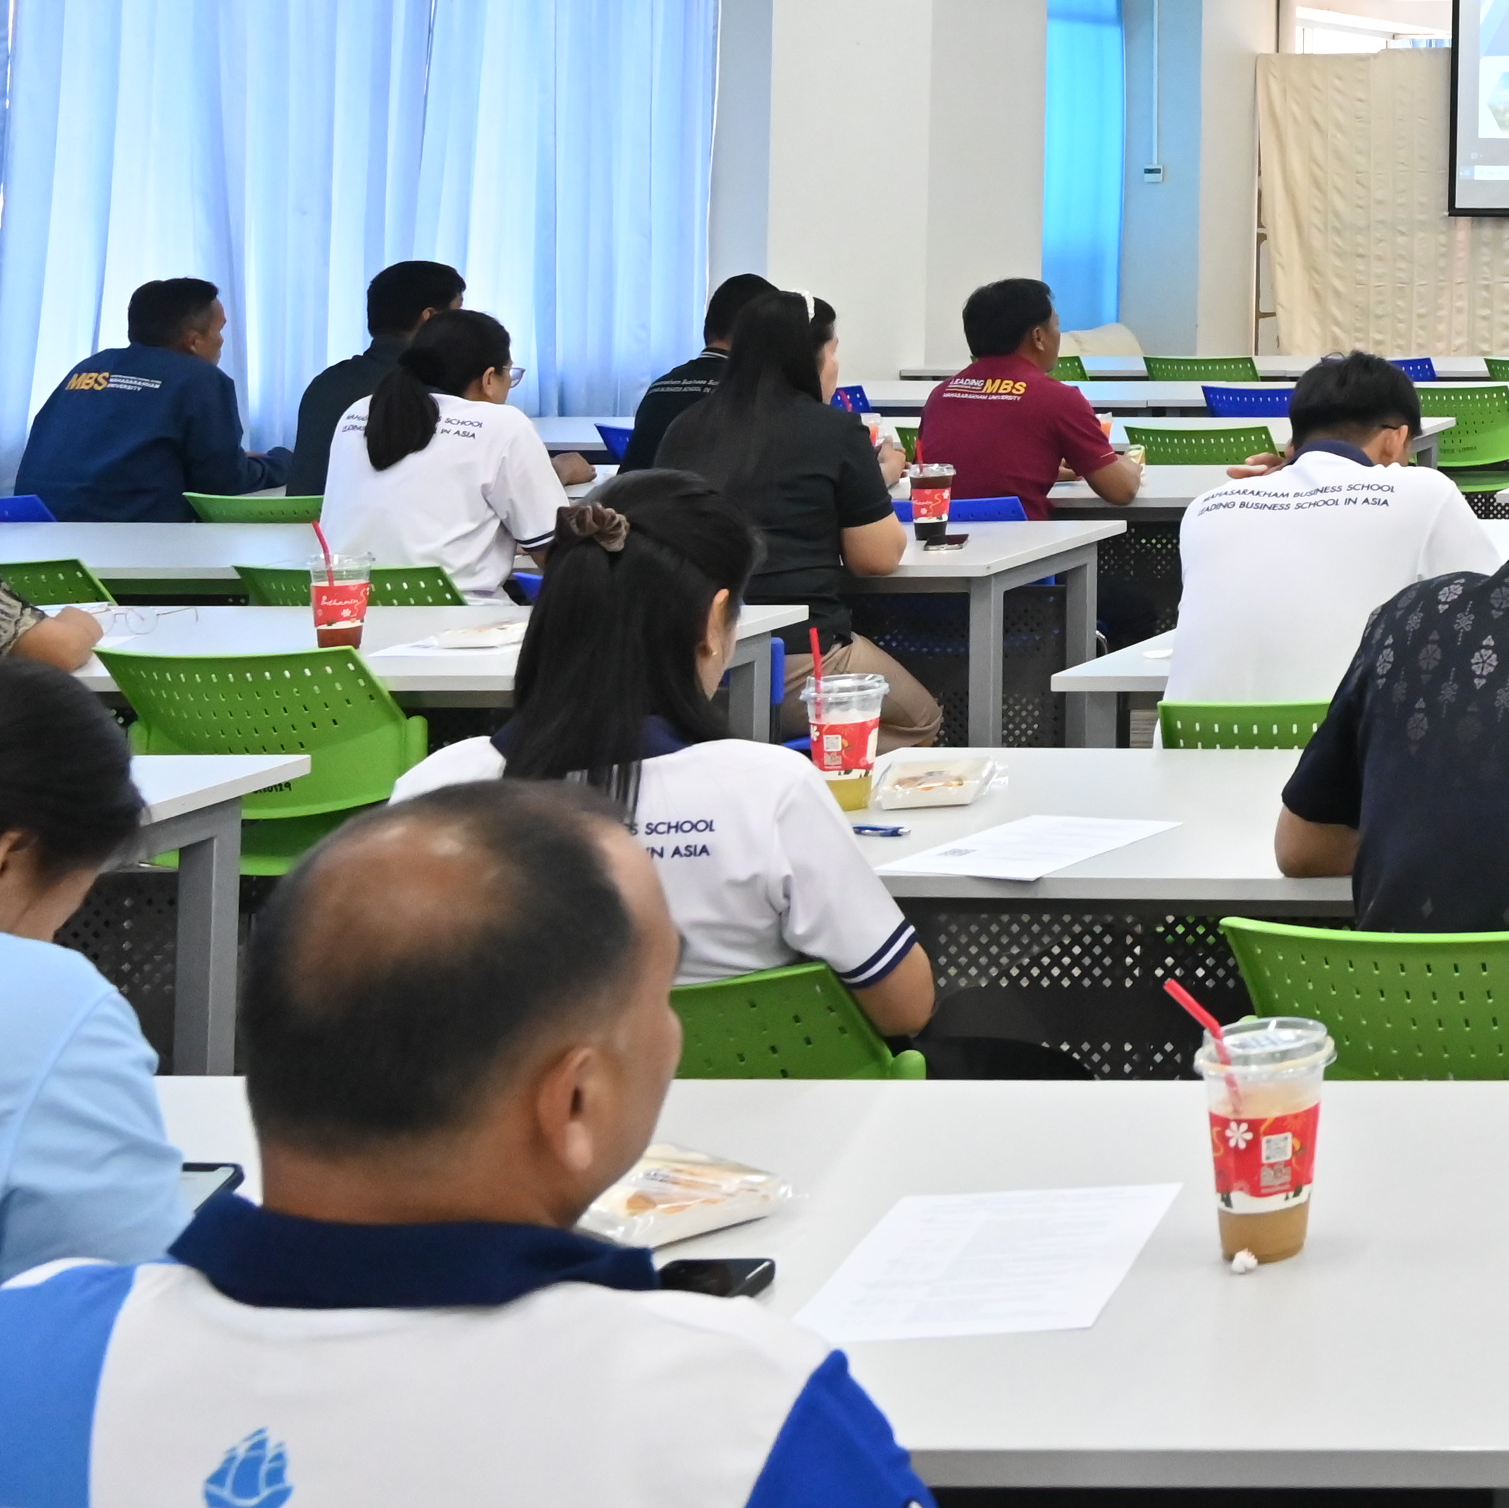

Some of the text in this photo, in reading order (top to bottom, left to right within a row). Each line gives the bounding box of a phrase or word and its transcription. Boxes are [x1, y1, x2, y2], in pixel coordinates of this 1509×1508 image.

[65, 372, 109, 390] MBS
[950, 378, 985, 387] LEADING
[982, 379, 1027, 394] MBS
[444, 417, 484, 428] SCHOOL
[453, 429, 476, 439] ASIA
[1293, 485, 1343, 498] BUSINESS
[1346, 483, 1396, 493] SCHOOL
[1198, 497, 1389, 516] LEADING BUSINESS SCHOOL IN ASIA
[645, 819, 715, 835] SCHOOL
[646, 844, 710, 859] N ASIA
